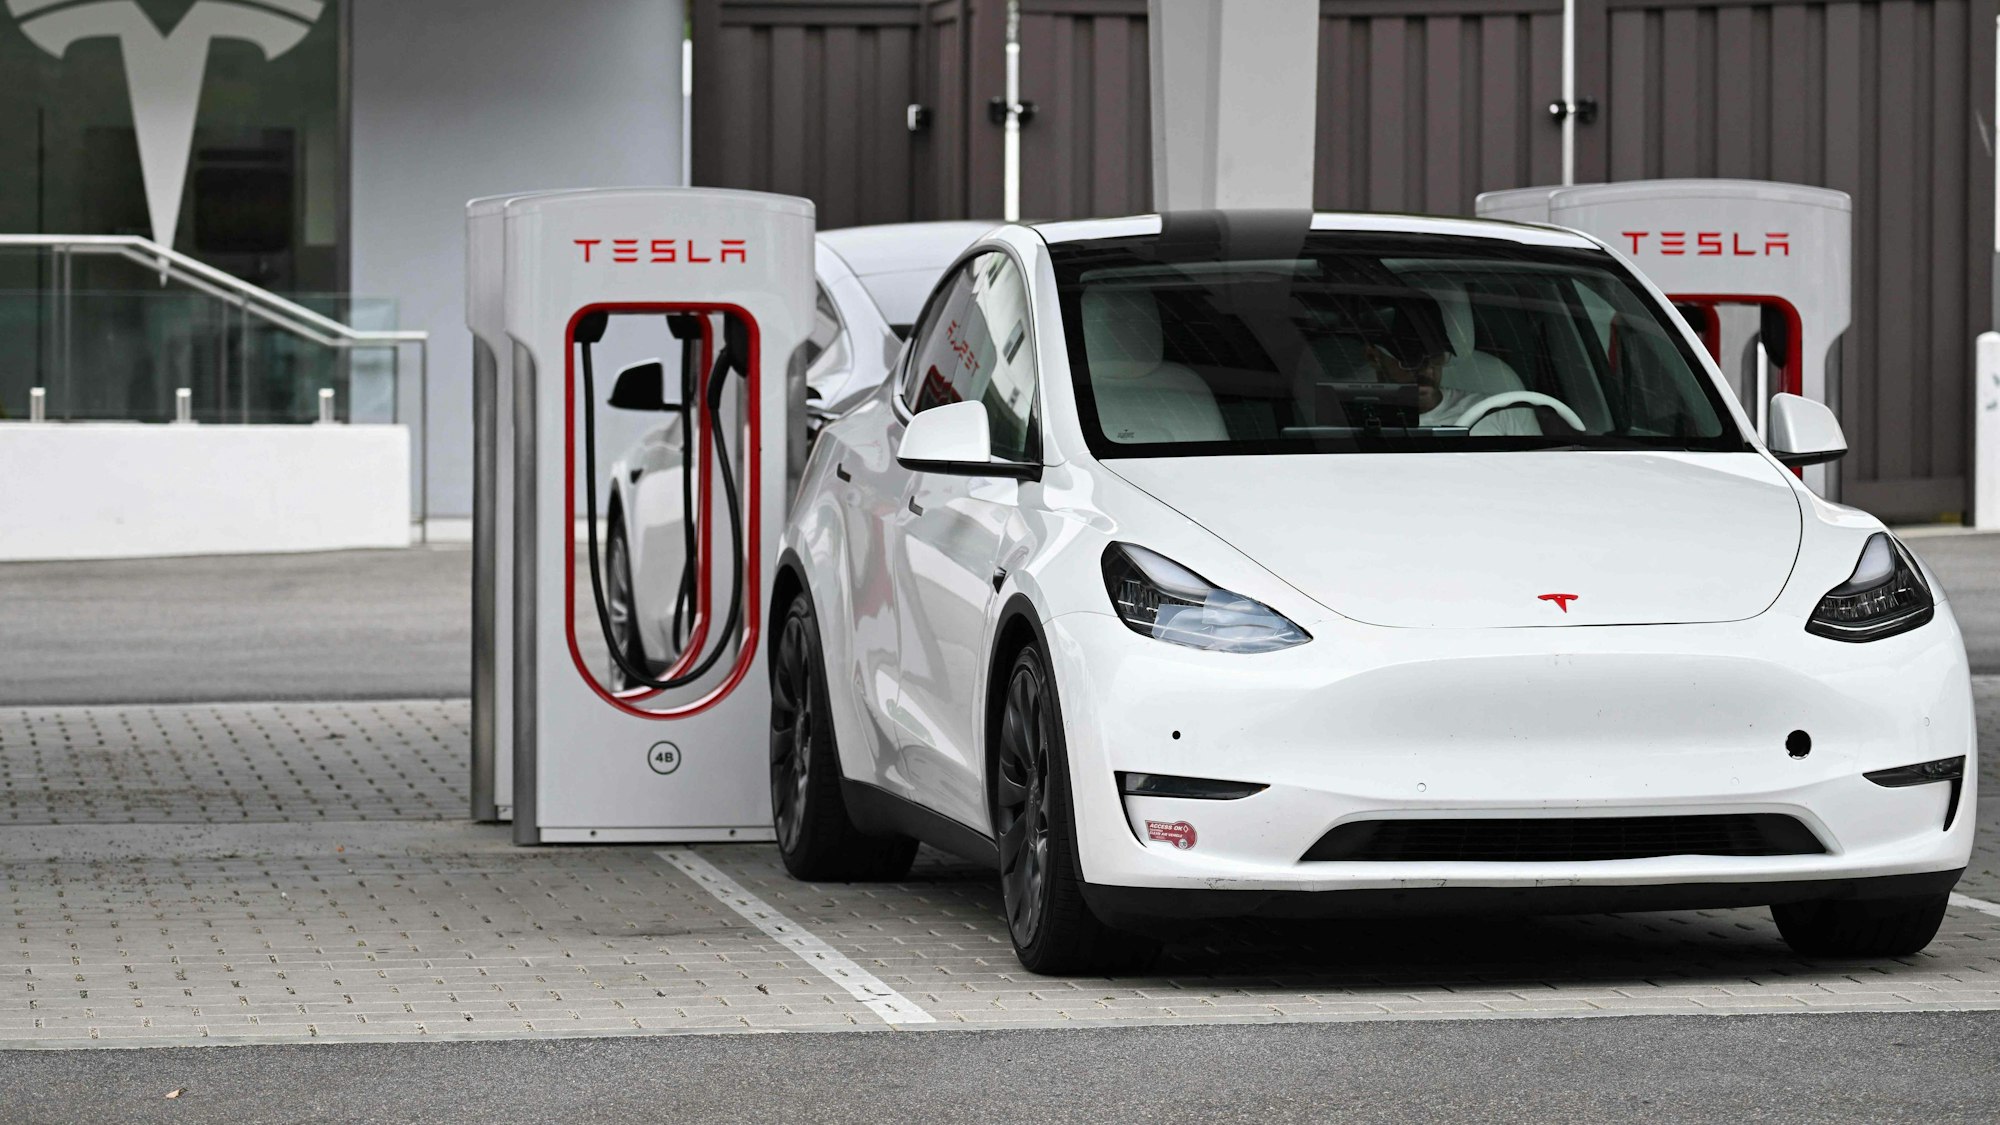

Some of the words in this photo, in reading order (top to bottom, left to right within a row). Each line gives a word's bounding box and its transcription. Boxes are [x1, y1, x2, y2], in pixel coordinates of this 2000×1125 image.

[573, 239, 746, 263] TESLA
[1621, 232, 1790, 256] TESLA
[655, 752, 674, 763] 4B
[1149, 823, 1173, 831] ACCESS
